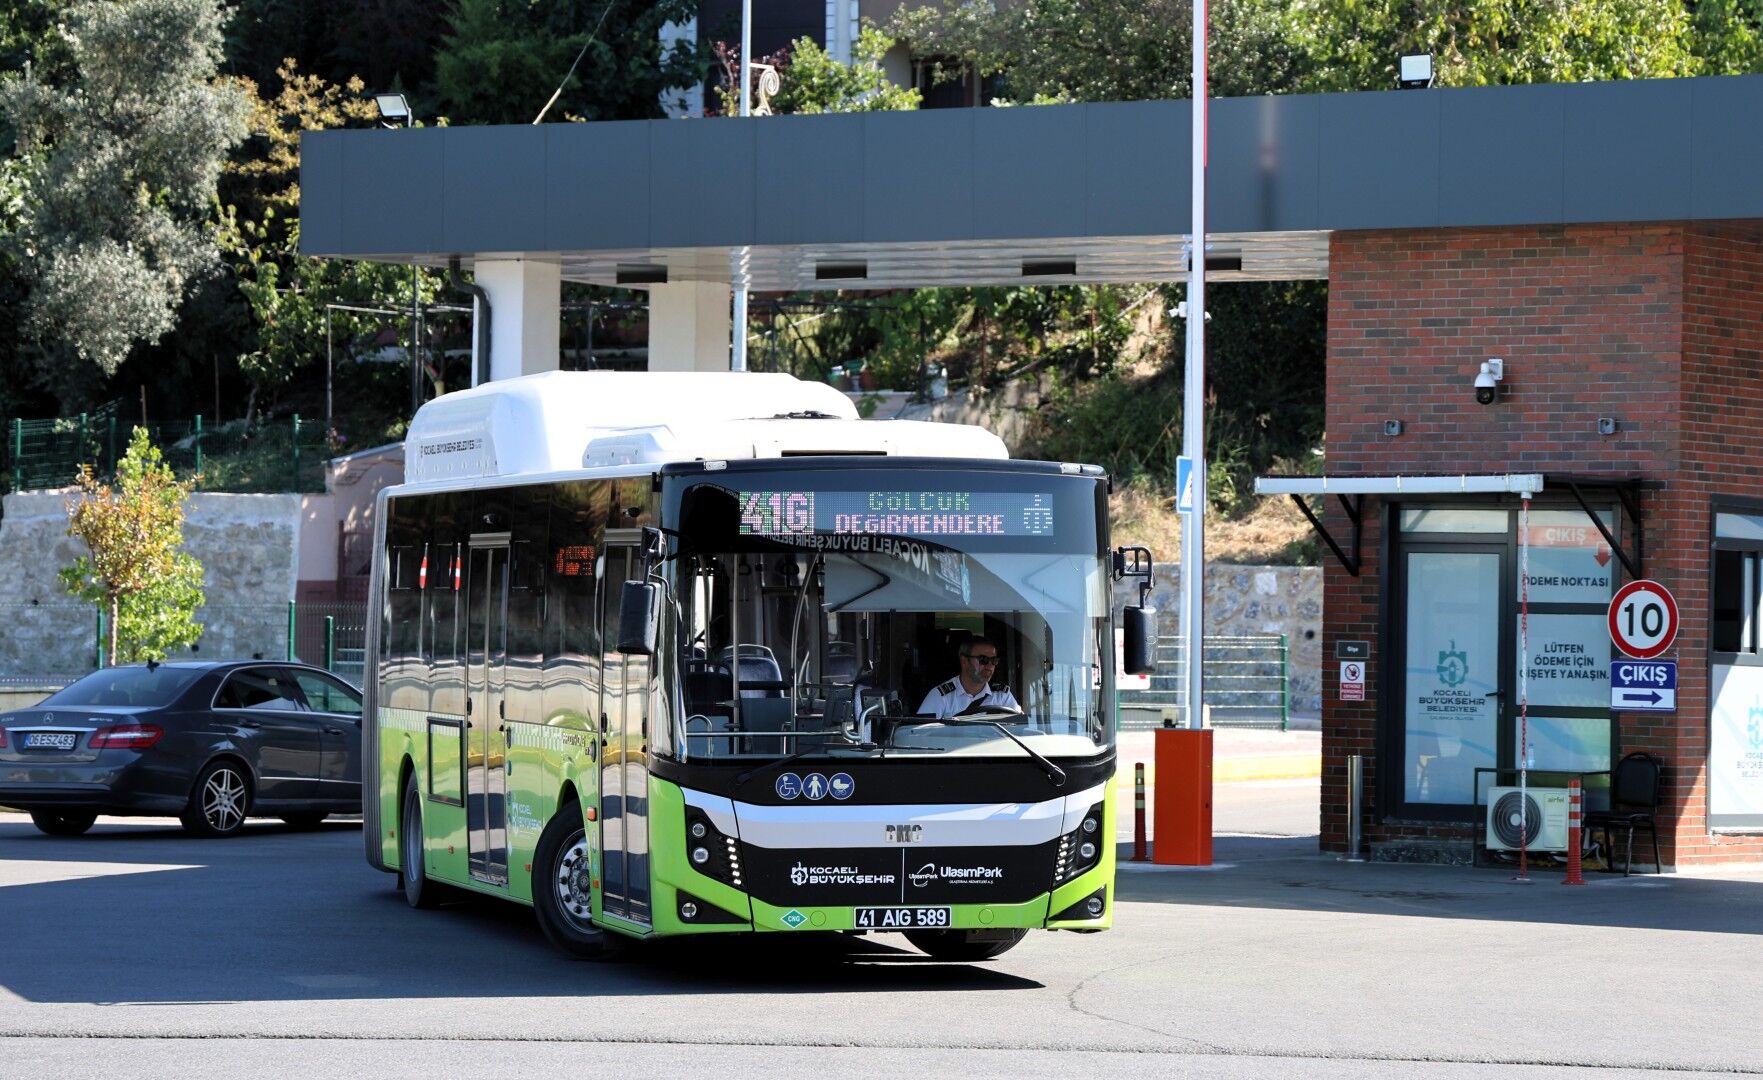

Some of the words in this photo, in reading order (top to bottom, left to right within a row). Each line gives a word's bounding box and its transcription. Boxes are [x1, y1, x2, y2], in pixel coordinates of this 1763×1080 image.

[869, 491, 970, 511] GÖLCÜK
[740, 492, 810, 532] 41G
[834, 513, 1005, 535] DEĞİRMENDERE
[1546, 527, 1586, 545] ÇIKIŞ
[1561, 576, 1609, 588] NOKTASI
[1624, 603, 1664, 637] 10
[1544, 642, 1584, 654] LÜTFEN
[1534, 653, 1571, 666] ÖDEME
[1573, 654, 1595, 668] İÇİN
[1560, 668, 1610, 681] YANAŞIN.
[1619, 665, 1668, 686] ÇIKIŞ
[1433, 689, 1471, 697] KOCAELİ
[1418, 697, 1486, 706] BÜYÜKŞEHİR
[1426, 705, 1478, 713] BELEDİYESİ
[809, 866, 858, 874] KOCAELİ
[809, 874, 895, 885] BÜYÜKŞEHİR
[858, 909, 875, 927] 41
[882, 909, 911, 926] AIG
[917, 909, 947, 926] 589
